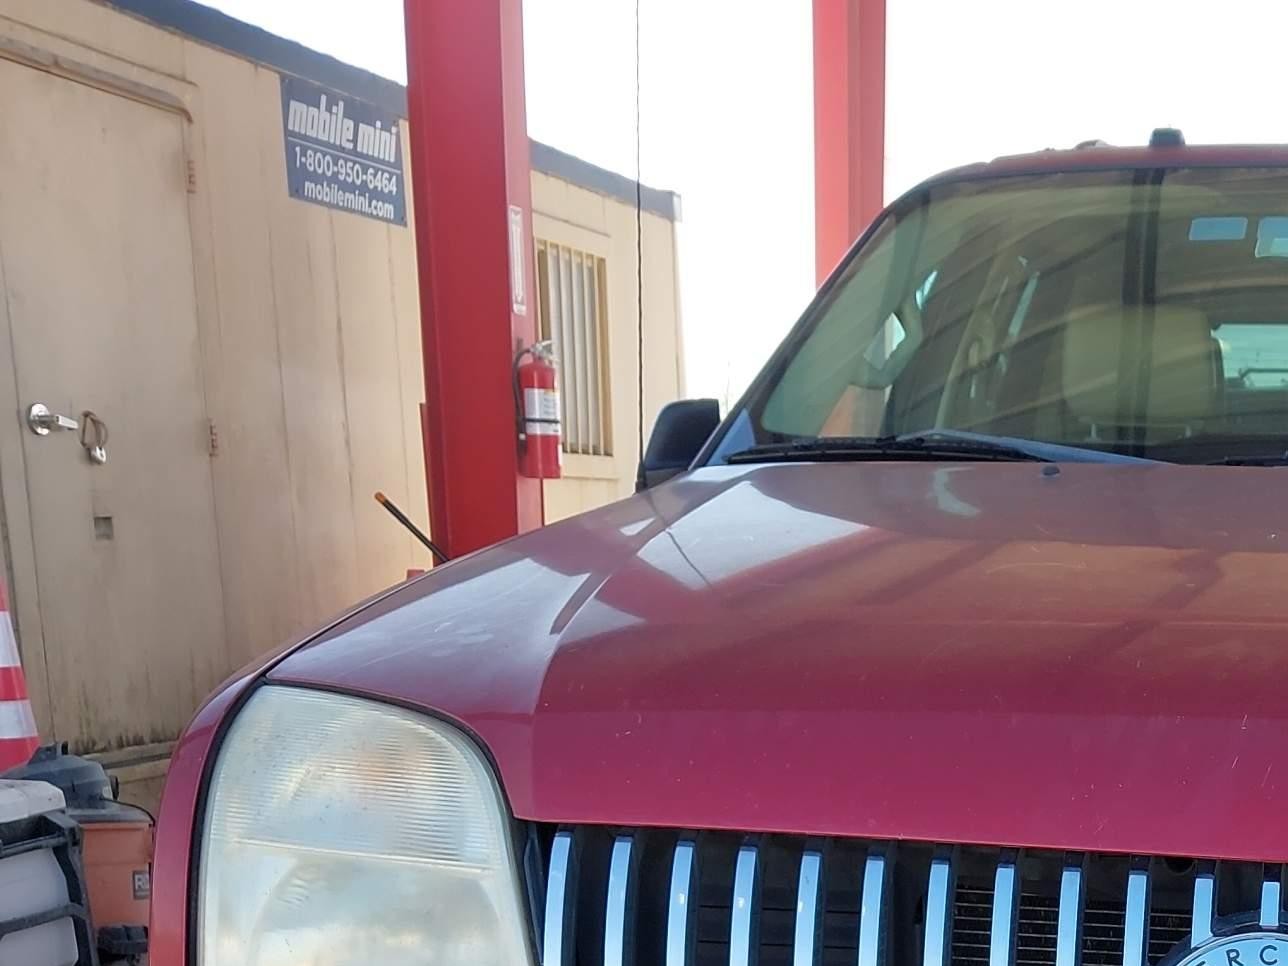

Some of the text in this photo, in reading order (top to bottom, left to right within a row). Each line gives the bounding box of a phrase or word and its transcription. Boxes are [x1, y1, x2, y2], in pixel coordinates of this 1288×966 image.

[288, 94, 397, 163] mobile mini
[295, 146, 397, 195] 1-800-950-6464
[304, 181, 394, 219] mobilemini.com
